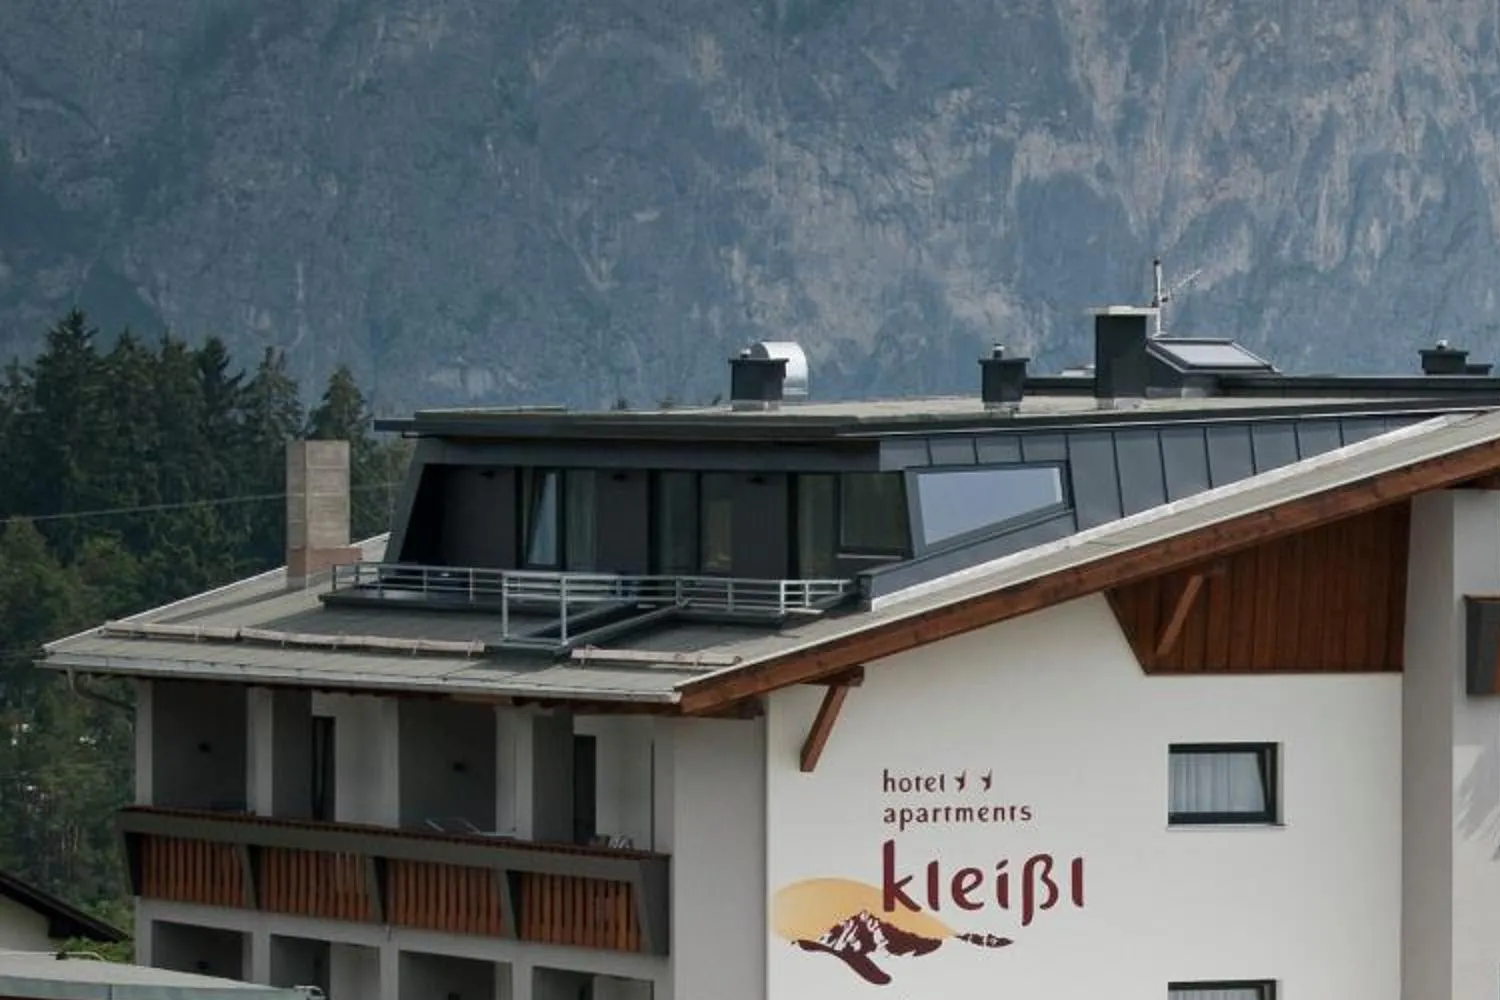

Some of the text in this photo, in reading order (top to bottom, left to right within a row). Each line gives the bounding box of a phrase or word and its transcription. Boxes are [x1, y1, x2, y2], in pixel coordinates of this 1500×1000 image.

[882, 768, 945, 793] hotel
[883, 804, 1032, 832] apartments
[882, 839, 1084, 927] kleißl
